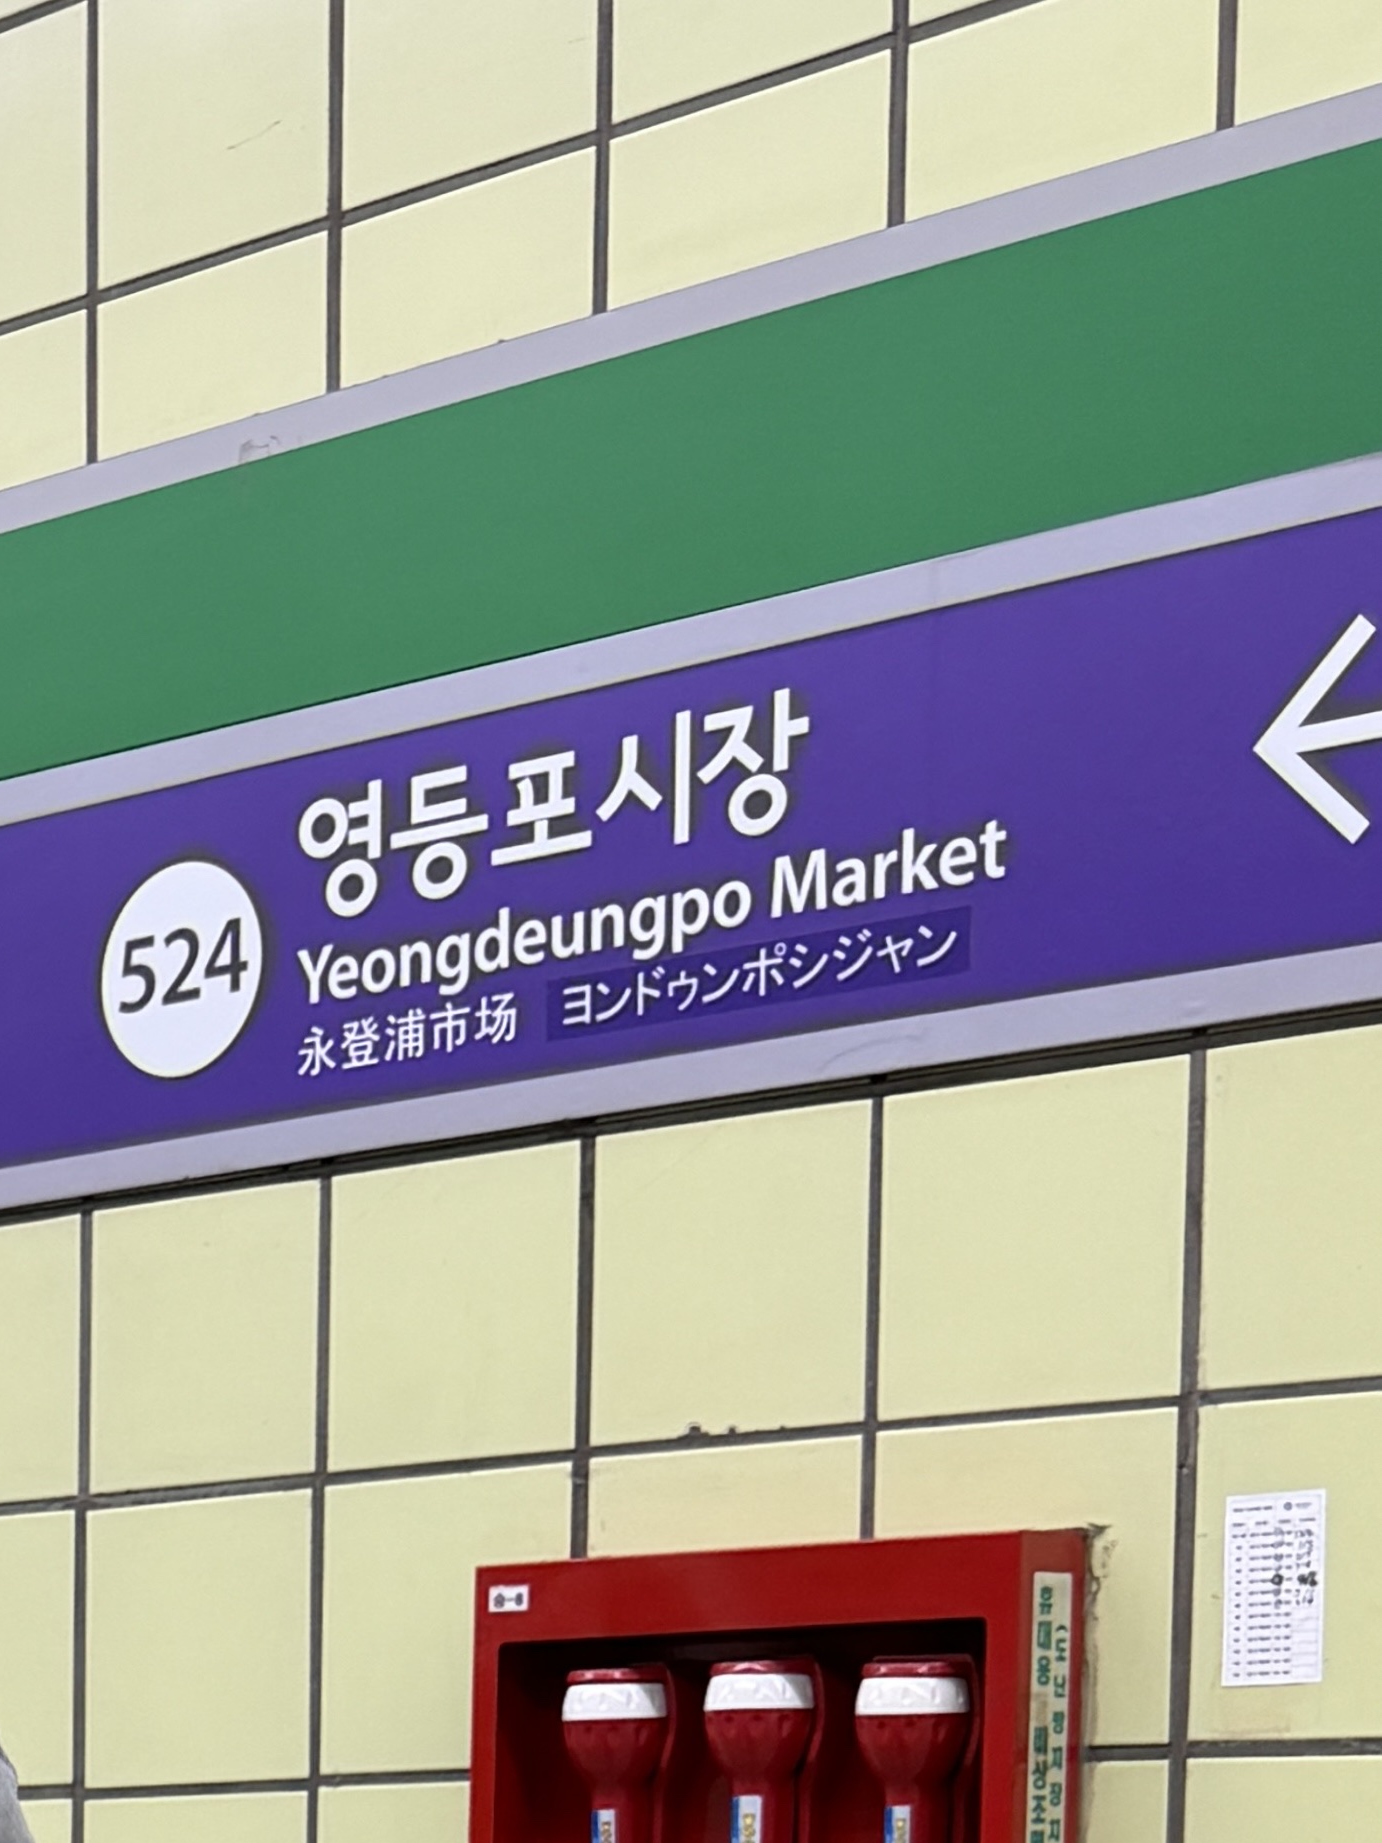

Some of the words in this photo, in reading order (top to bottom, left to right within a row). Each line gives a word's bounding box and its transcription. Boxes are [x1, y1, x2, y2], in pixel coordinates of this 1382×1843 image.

[297, 688, 811, 920] 영등포시장
[116, 914, 250, 1014] 524
[295, 876, 750, 1006] Yeongdeungpo
[769, 818, 1009, 919] Market
[561, 923, 958, 1028] ヨンドゥンポシジャン
[296, 993, 519, 1078] 永登浦市场
